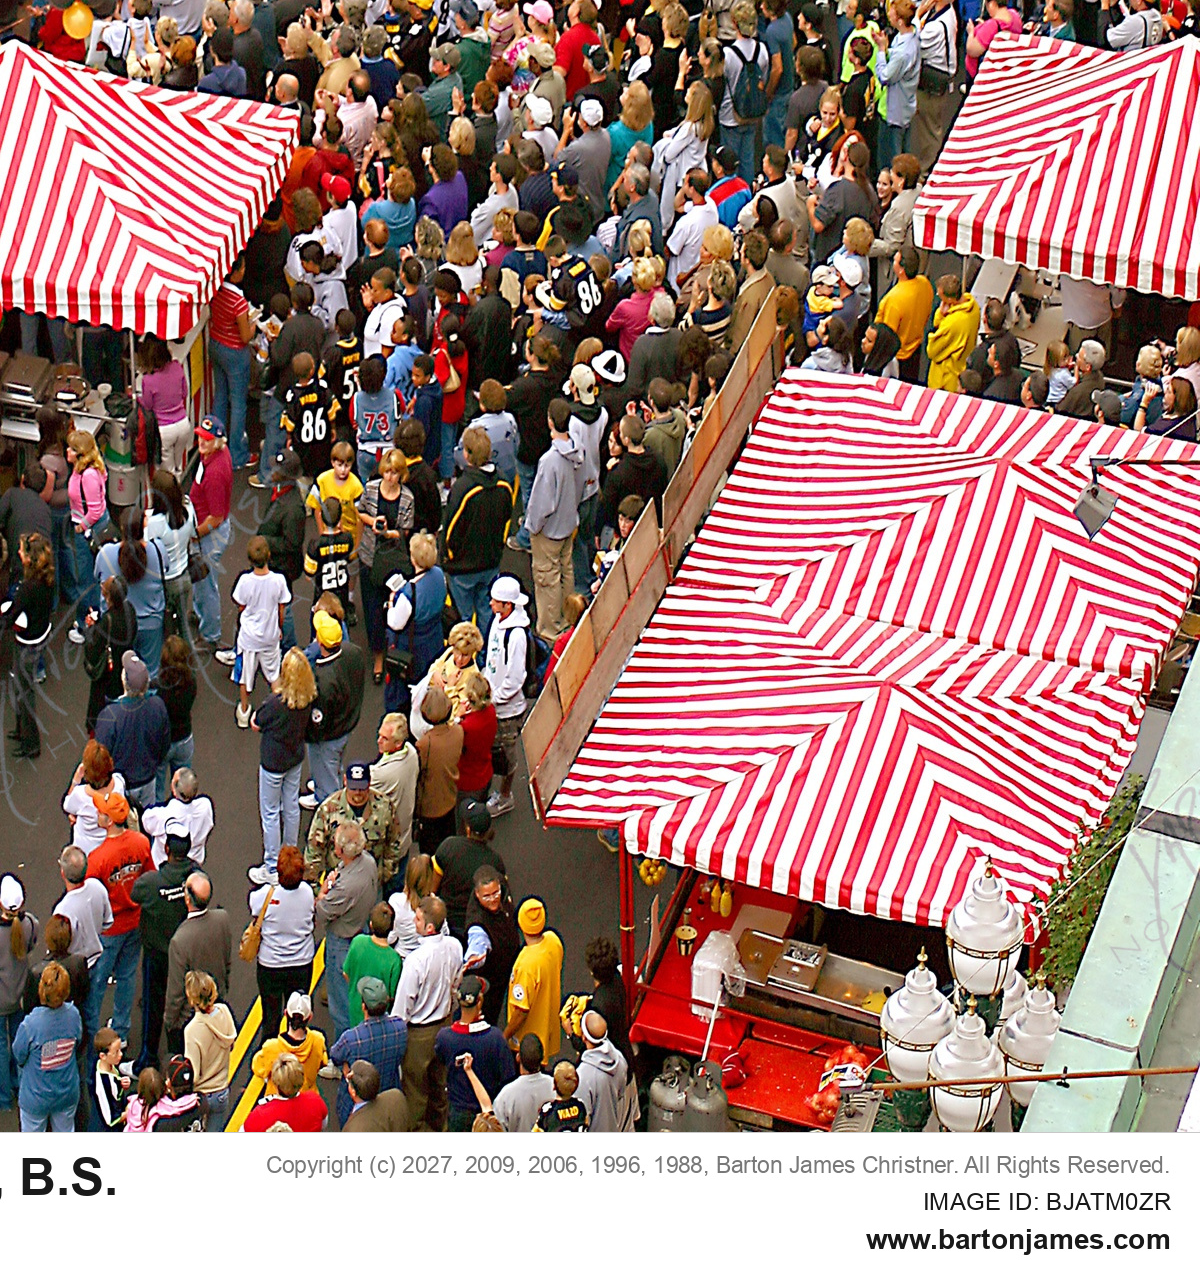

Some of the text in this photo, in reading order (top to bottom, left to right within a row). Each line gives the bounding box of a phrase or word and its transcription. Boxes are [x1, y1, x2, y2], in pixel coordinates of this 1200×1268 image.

[577, 272, 602, 314] 86
[299, 392, 318, 406] WARD
[301, 407, 326, 443] 86
[364, 412, 389, 434] 73
[322, 560, 347, 590] 26
[557, 1106, 579, 1120] WARD
